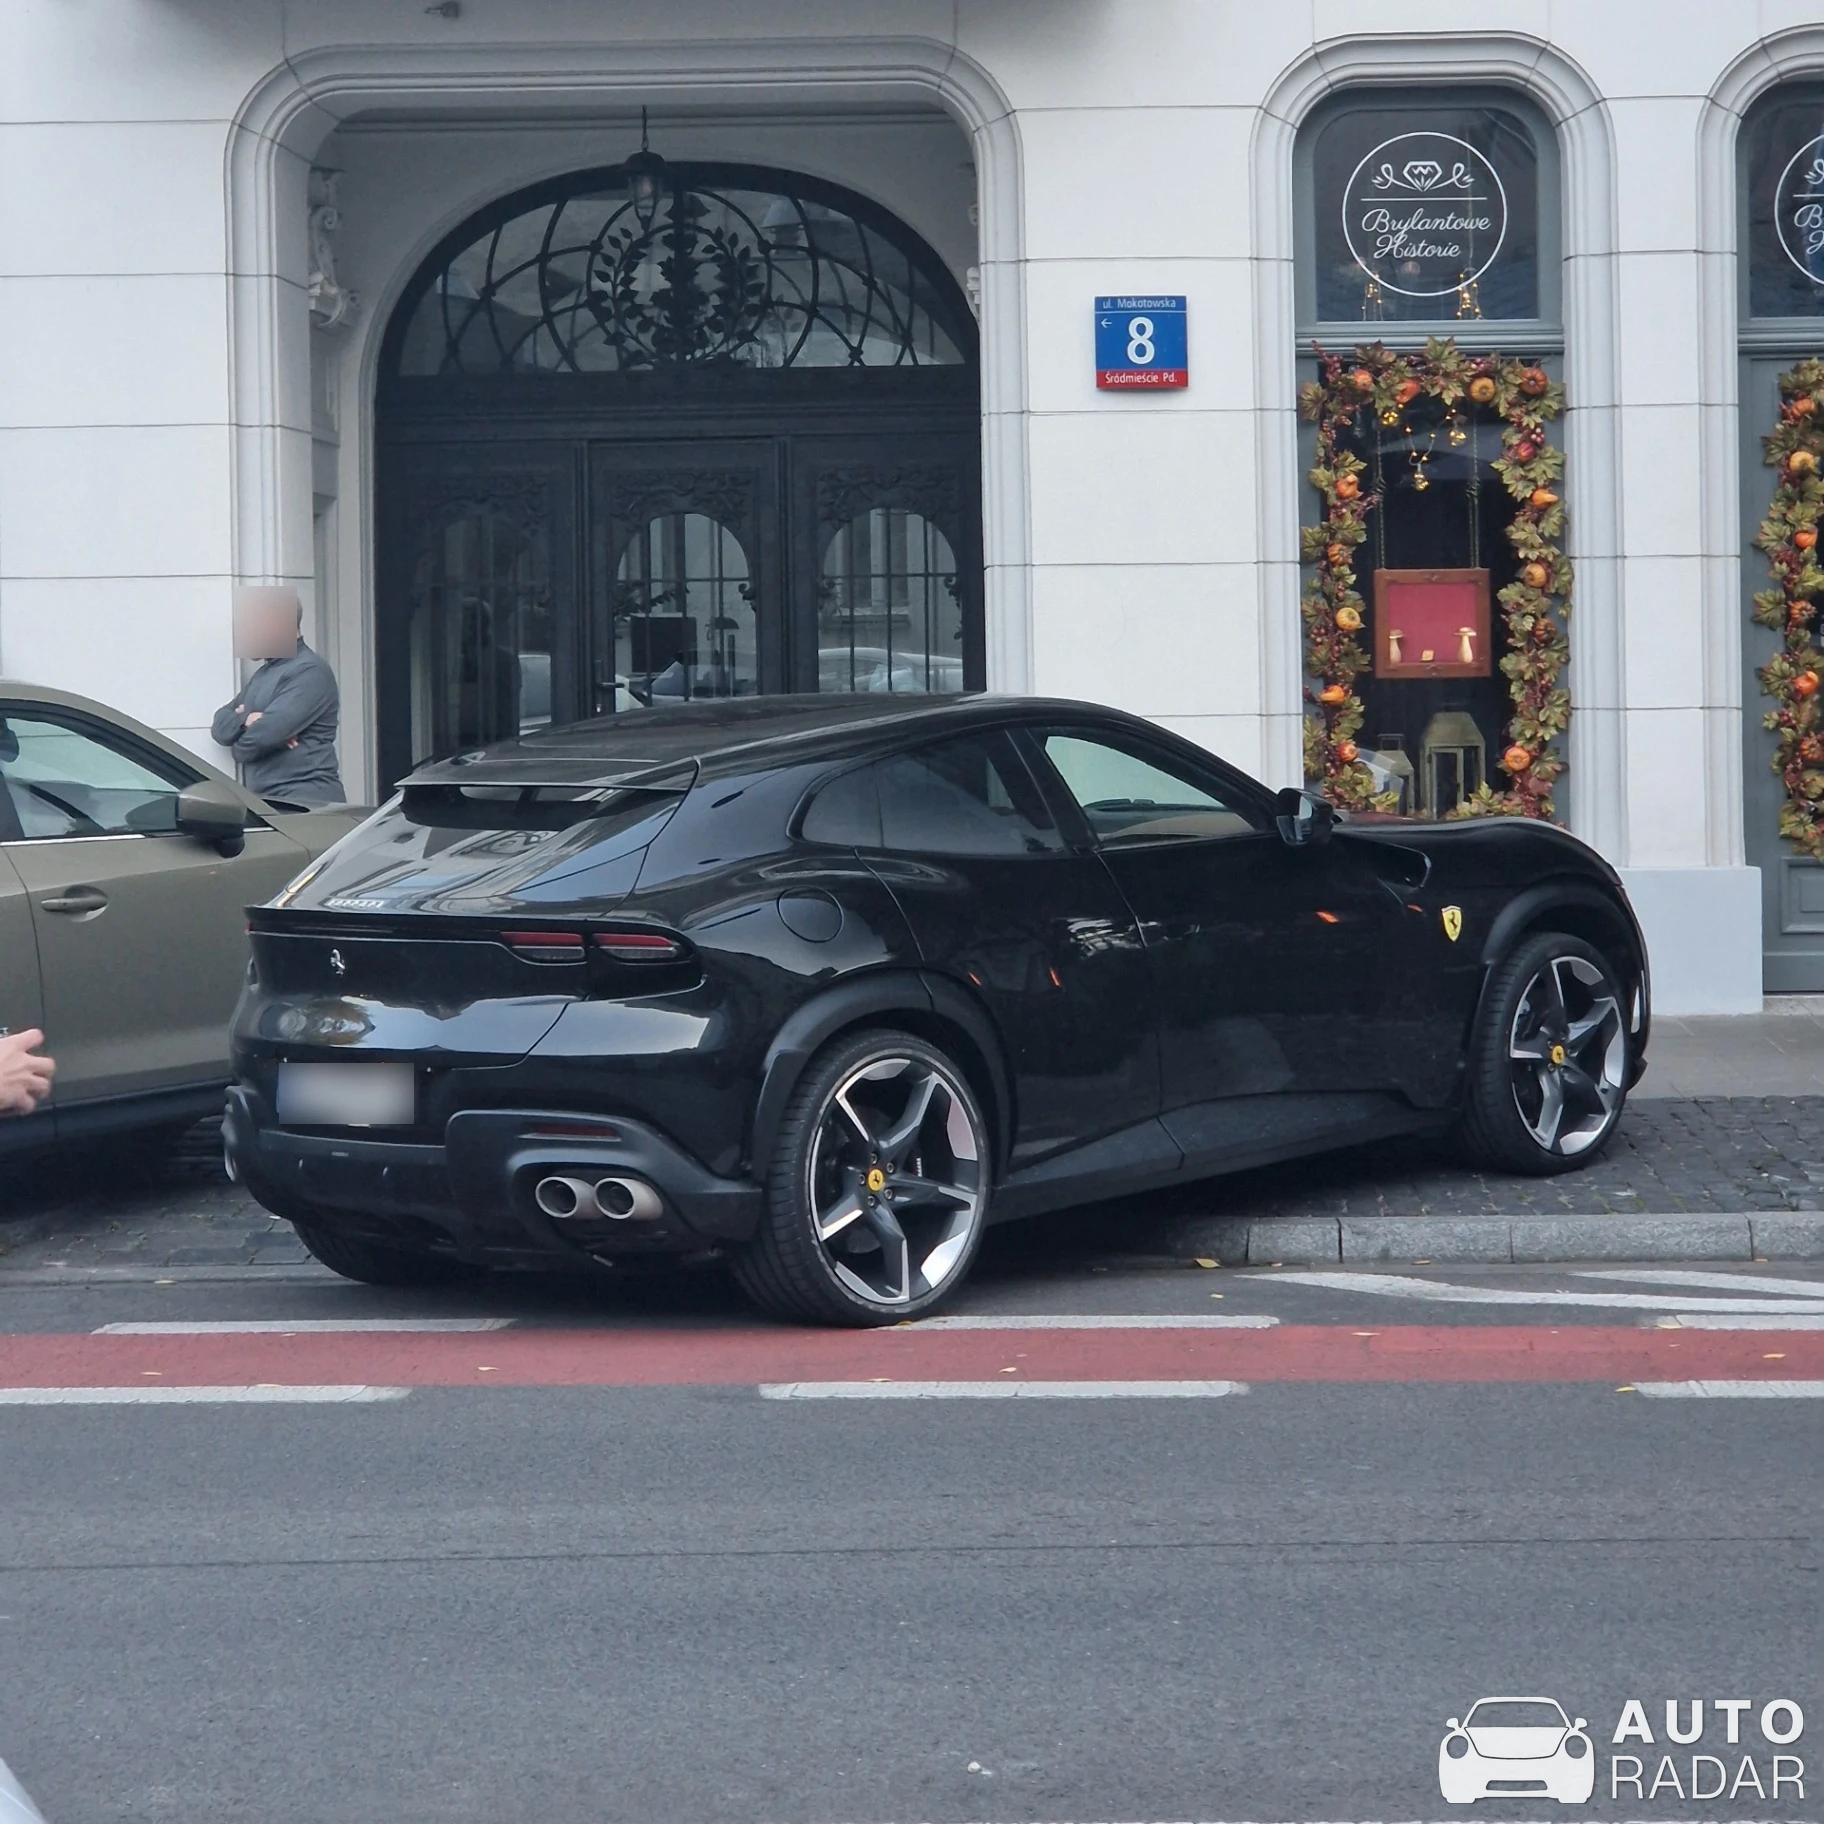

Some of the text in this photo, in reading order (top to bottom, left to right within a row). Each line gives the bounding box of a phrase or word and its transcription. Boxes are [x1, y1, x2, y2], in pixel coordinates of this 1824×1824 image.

[1361, 207, 1491, 238] Brylantowe
[1373, 233, 1461, 259] Historie
[1102, 297, 1176, 309] ul. Mokotowska
[1127, 316, 1155, 365] 8
[1105, 370, 1178, 384] Śródmieście Pd.
